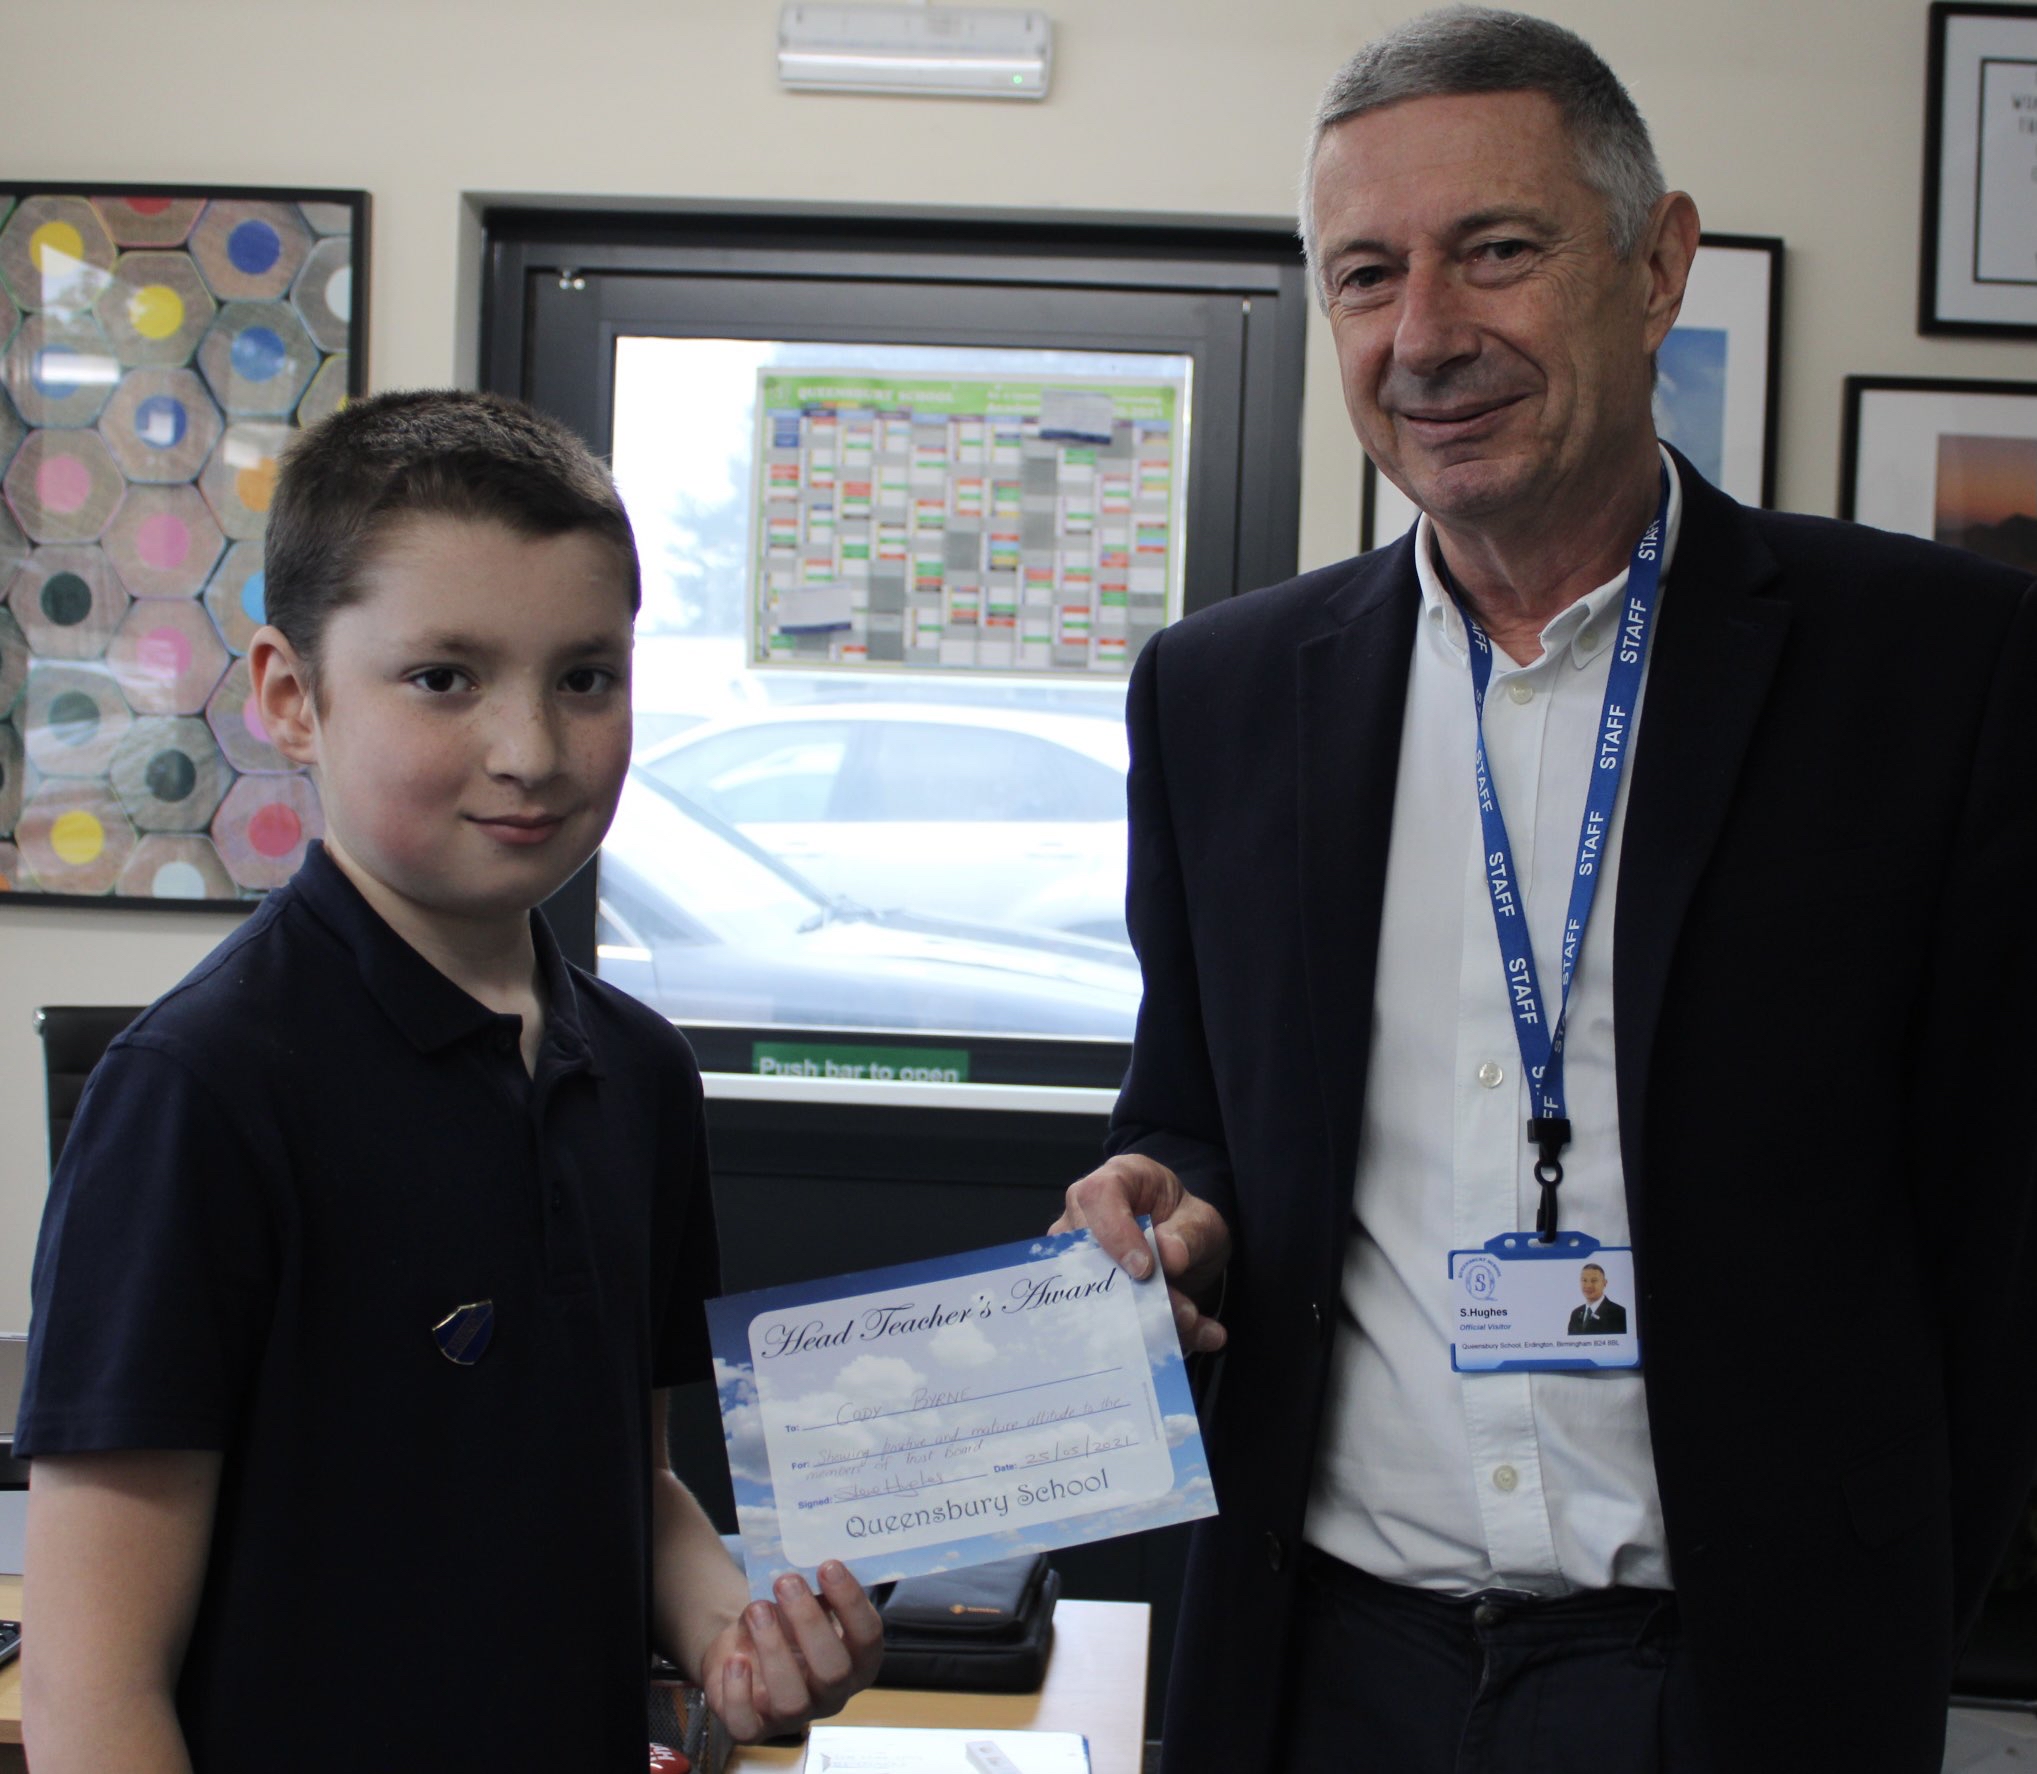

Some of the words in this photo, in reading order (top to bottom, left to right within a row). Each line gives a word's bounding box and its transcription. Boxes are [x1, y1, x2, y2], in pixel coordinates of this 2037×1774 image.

[1620, 597, 1647, 664] STAFF
[1600, 704, 1626, 770] STAFF
[1475, 749, 1493, 813] STAFF
[1579, 810, 1604, 876] STAFF
[1489, 851, 1515, 918] STAFF
[1562, 918, 1581, 985] STAFF
[1509, 957, 1538, 1025] STAFF
[759, 1057, 819, 1077] Push
[824, 1059, 864, 1079] bar
[869, 1062, 894, 1081] to
[900, 1065, 960, 1083] open
[761, 1320, 854, 1359] Head
[860, 1295, 992, 1341] Teacher's
[1001, 1267, 1117, 1315] Award
[1460, 1308, 1508, 1318] S.Hughes
[785, 1424, 801, 1433] To:
[934, 1426, 960, 1444] and
[994, 1463, 1017, 1473] Date:
[797, 1496, 833, 1510] Signed:
[846, 1494, 1008, 1537] Queensbury
[1017, 1468, 1108, 1506] School
